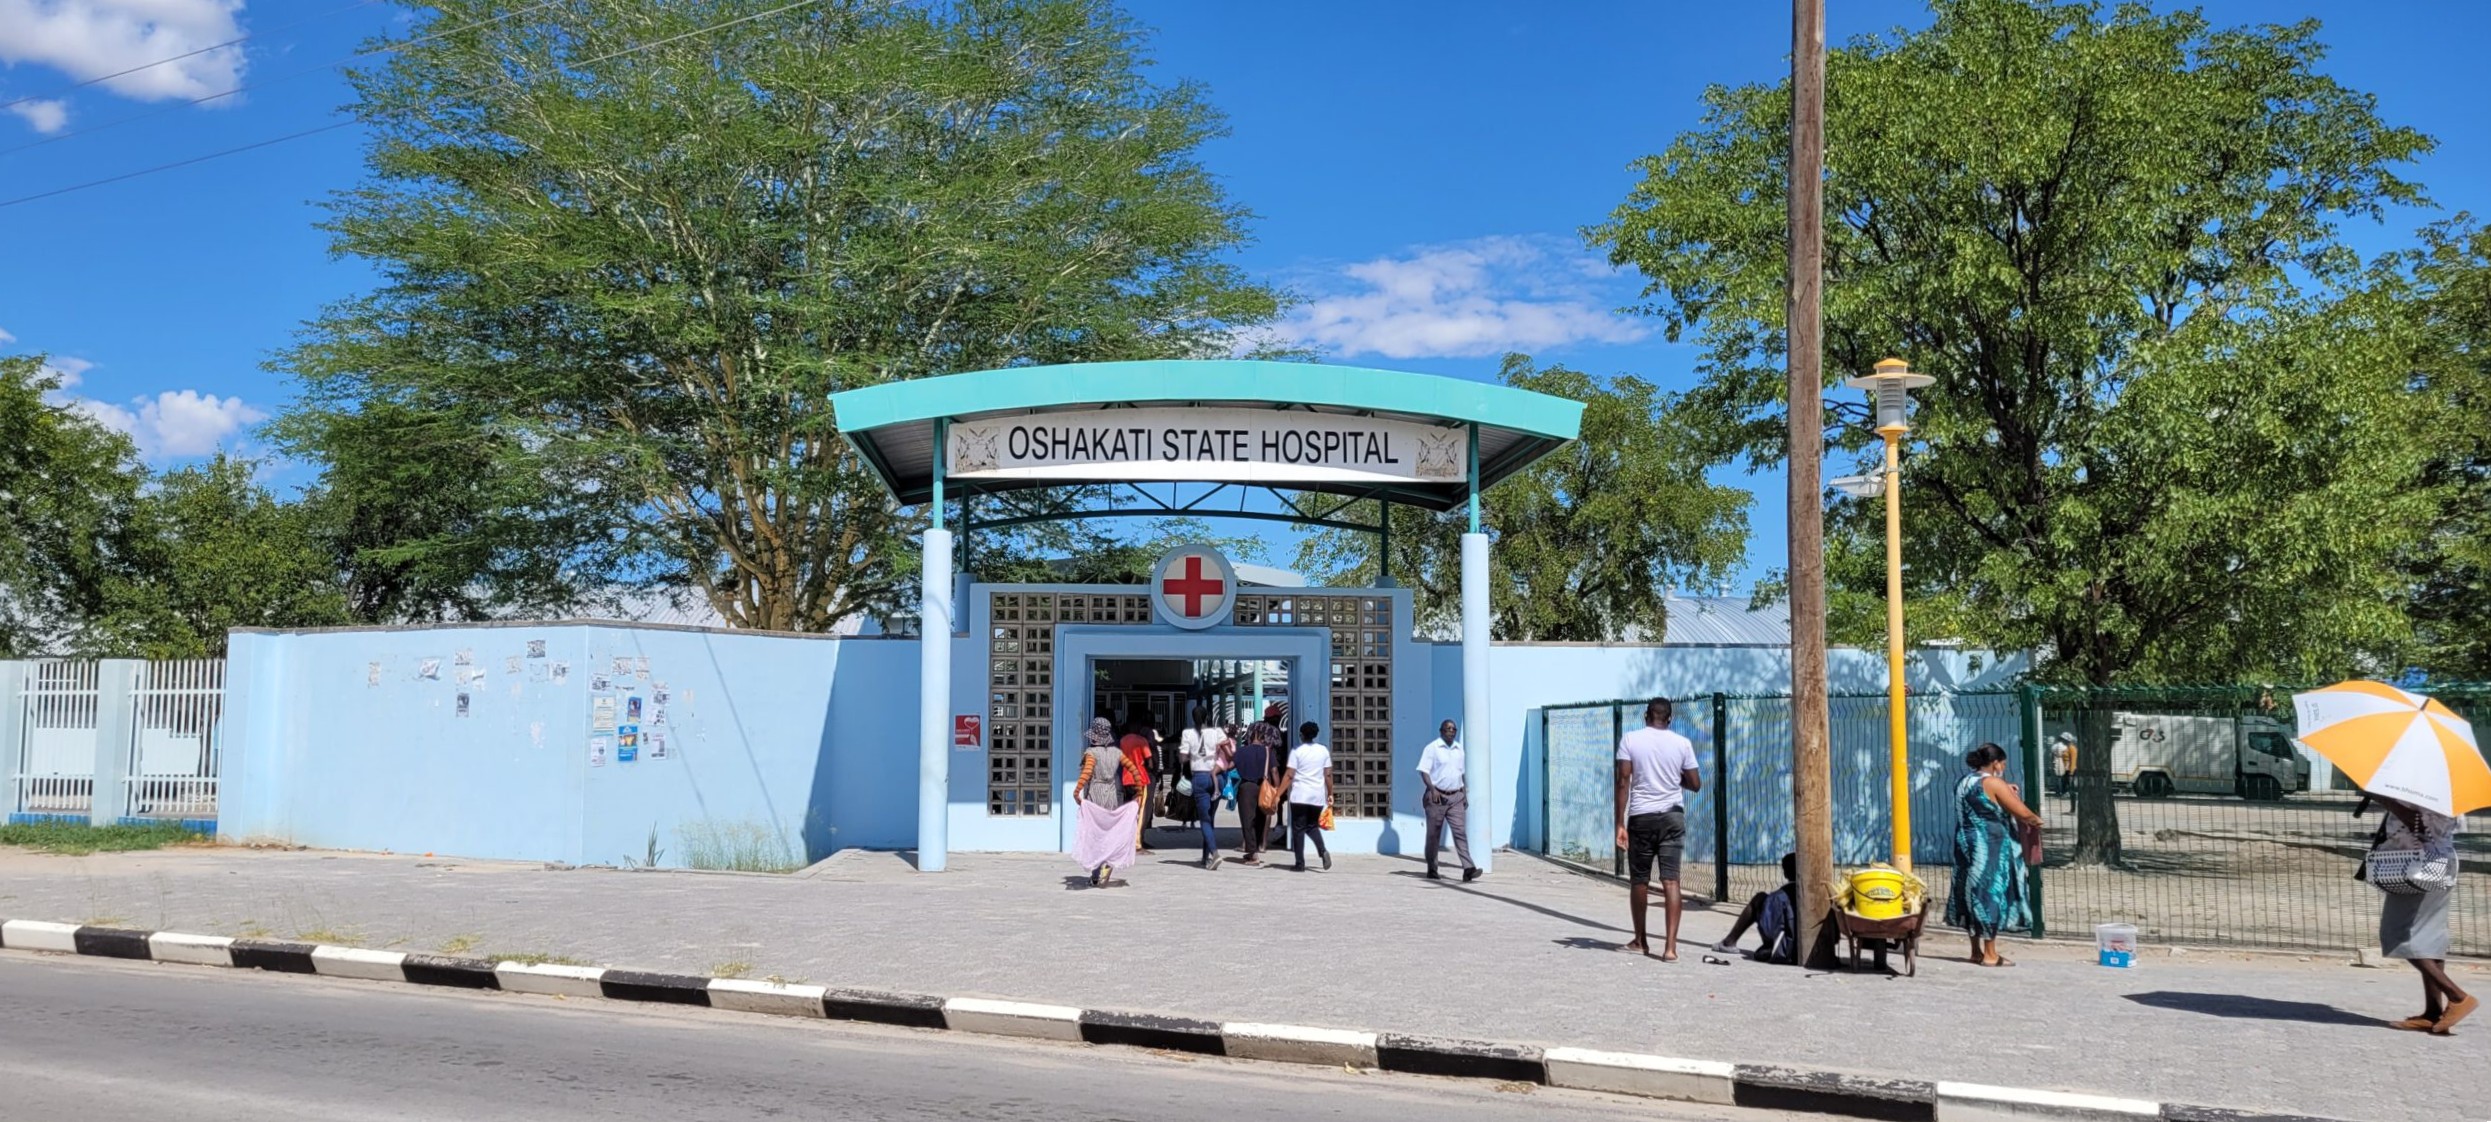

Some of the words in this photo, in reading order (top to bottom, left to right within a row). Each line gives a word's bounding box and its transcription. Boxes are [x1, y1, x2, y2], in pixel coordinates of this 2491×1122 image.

[1008, 426, 1152, 461] OSHAKATI
[1162, 428, 1249, 462] STATE
[1261, 430, 1399, 464] HOSPITAL
